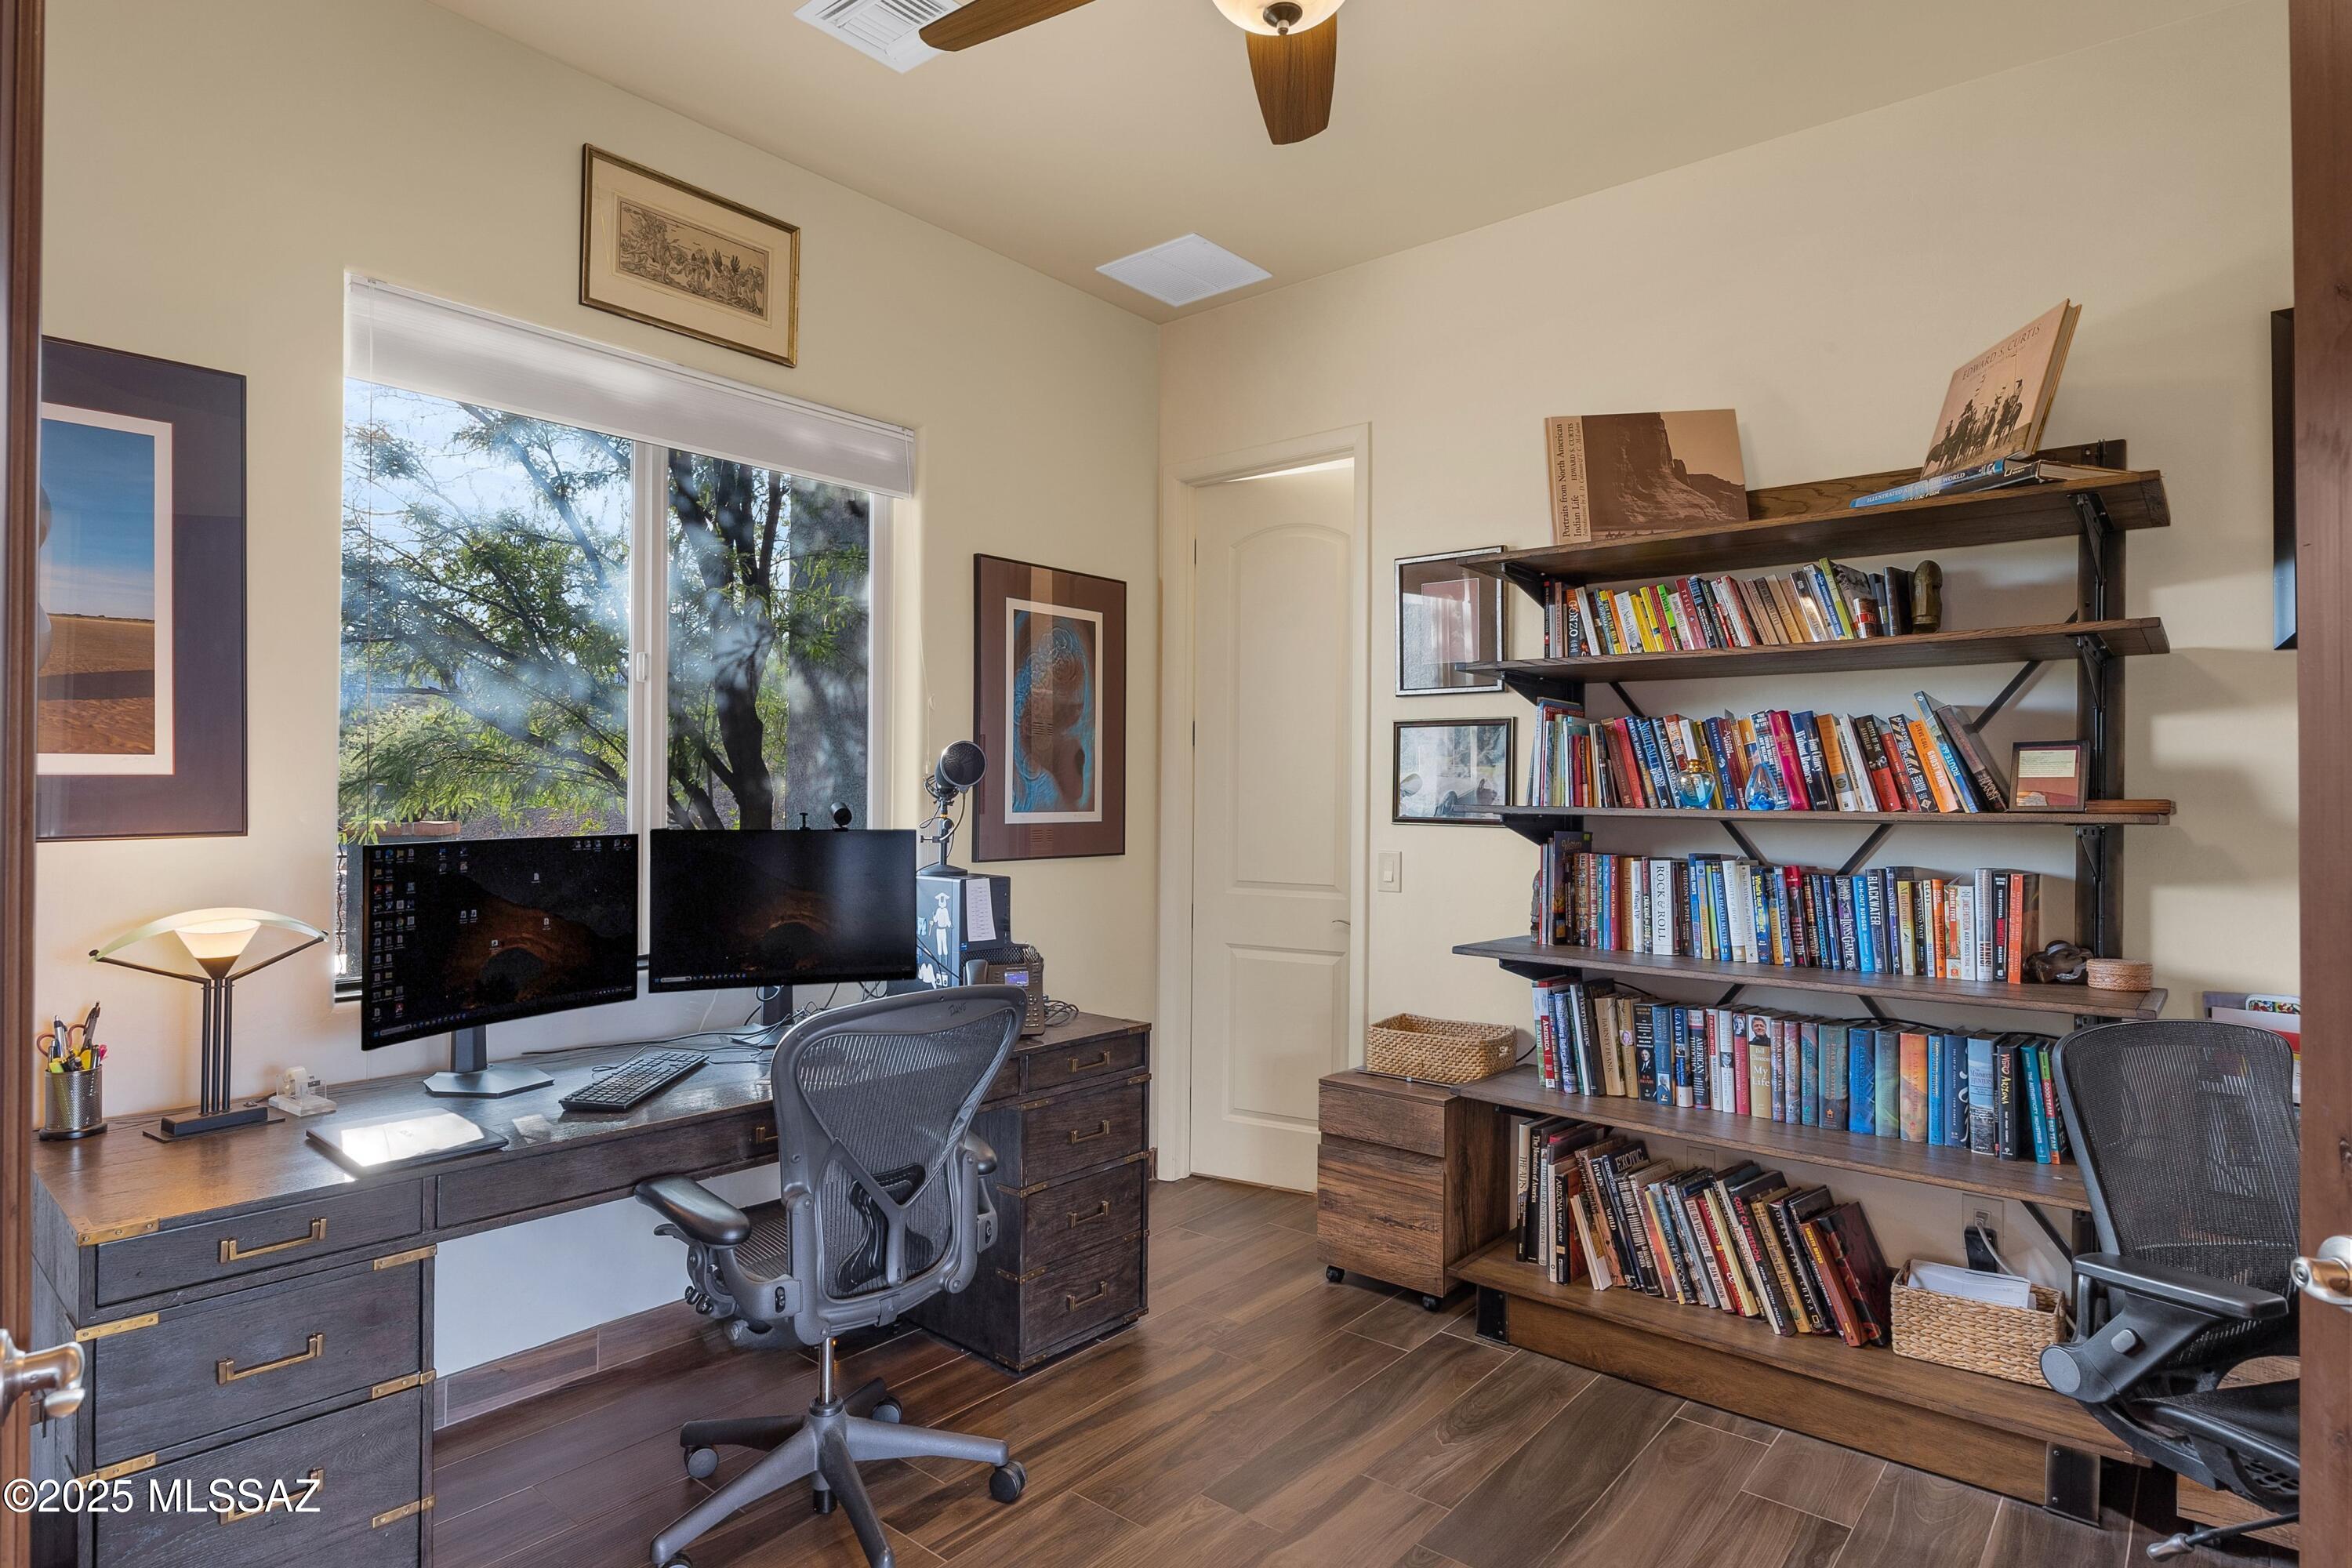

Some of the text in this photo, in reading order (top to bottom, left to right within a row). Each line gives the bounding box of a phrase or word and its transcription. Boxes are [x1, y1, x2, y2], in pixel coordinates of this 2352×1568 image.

[1962, 352, 1997, 381] EDWARD
[2007, 323, 2042, 350] CURTIS
[1555, 423, 1564, 458] American
[1560, 505, 1570, 536] Portraits
[1572, 512, 1581, 537] Indian
[1681, 589, 1692, 612] TESLA
[1764, 594, 1775, 613] SECOND
[1771, 613, 1780, 625] CITY
[1568, 600, 1577, 637] GONZO
[1627, 717, 1638, 741] TREVOR
[1634, 742, 1642, 759] NOAH
[1712, 732, 1721, 751] BRYSON
[1860, 726, 1872, 750] AYATOLLAH
[1865, 720, 1875, 737] GUESTS
[1895, 715, 1909, 741] ANDREW
[1915, 723, 1929, 749] STEVE COLL
[1661, 738, 1671, 760] LENNON
[1794, 730, 1816, 784] Without Remorse
[1808, 736, 1825, 773] Tom Clancy
[1900, 750, 1915, 776] MUELLER
[1940, 744, 1960, 777] ROUTE 66
[1655, 766, 1666, 786] NELSON
[1926, 750, 1947, 788] GHOST WARS
[1656, 865, 1664, 897] ROCK
[1842, 878, 1851, 900] NELSON
[1634, 910, 1640, 919] Up
[1866, 876, 1882, 925] BLACKWATER
[1900, 887, 1910, 929] Mudbound
[1555, 1000, 1566, 1037] Williamsburg
[1577, 996, 1586, 1018] Victory
[1542, 1019, 1551, 1051] AMERICA
[1581, 1025, 1590, 1047] Europe
[1602, 1018, 1610, 1047] BARNEY
[1674, 1013, 1682, 1042] GABBY
[1695, 1036, 1704, 1073] AMERICAN
[2000, 1054, 2010, 1074] WEIRD
[1752, 1078, 1770, 1087] Life
[1754, 1065, 1768, 1077] My
[2000, 1075, 2011, 1104] ARIZONA
[2028, 1081, 2038, 1114] AUTHENTICITY
[2033, 1116, 2042, 1144] INDUSTRIES
[1519, 1155, 1527, 1169] THE
[1603, 1160, 1613, 1180] EXOTIC
[1615, 1149, 1643, 1173] EXOTIC
[1518, 1171, 1526, 1189] ALPS
[1686, 1201, 1697, 1212] THE
[1693, 1221, 1705, 1237] VINCI
[1699, 1237, 1710, 1253] CODE
[1733, 1196, 1744, 1214] COST
[1744, 1225, 1762, 1261] FREEDOM
[1773, 1207, 1814, 1311] JOURNEY INTO CHINA
[1804, 1226, 1824, 1265] SMOOTH MOVES
[1709, 1265, 1726, 1299] DAN BROWN
